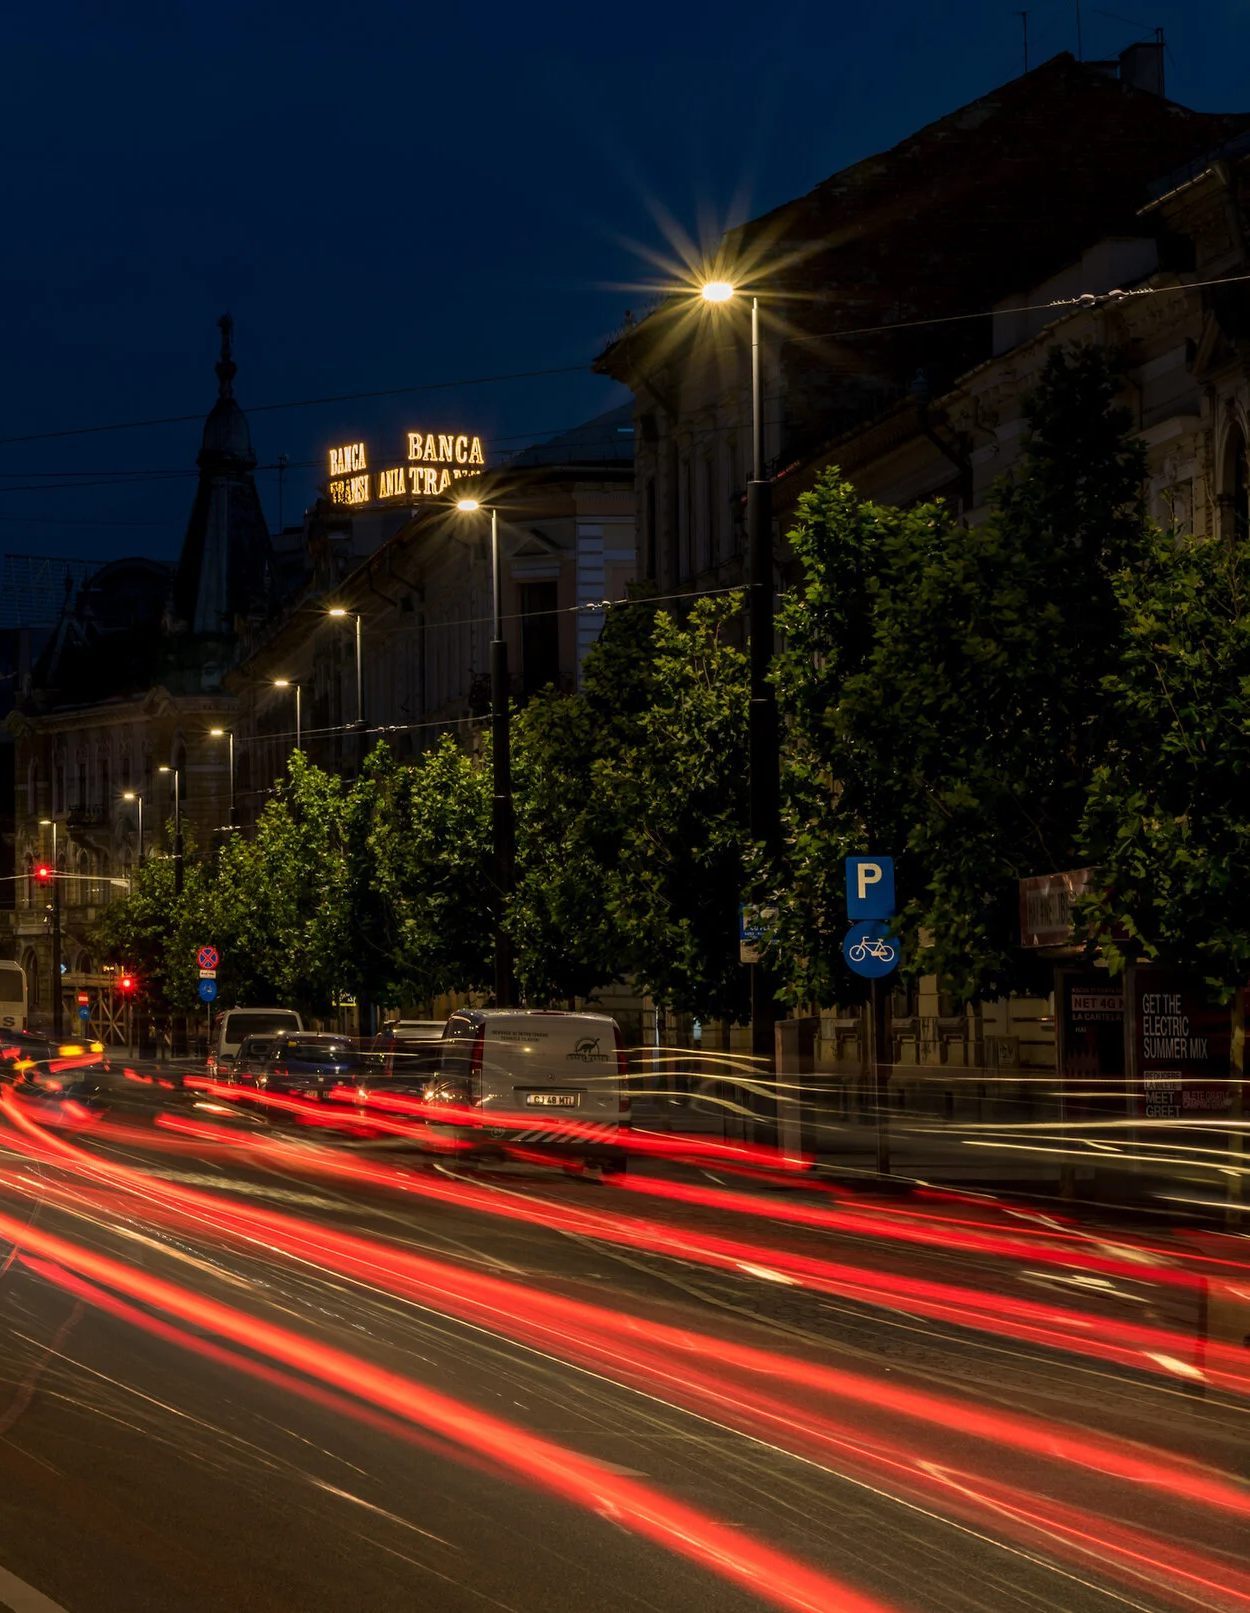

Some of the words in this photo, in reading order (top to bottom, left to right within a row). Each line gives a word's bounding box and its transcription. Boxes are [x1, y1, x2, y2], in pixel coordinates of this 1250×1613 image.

[408, 433, 484, 464] BANCA
[329, 443, 366, 476] BANCA
[857, 862, 883, 899] P
[1074, 998, 1096, 1008] NET
[1101, 998, 1115, 1008] 4G
[1142, 993, 1161, 1014] GET
[1162, 993, 1182, 1015] THE
[1072, 1012, 1083, 1021] LA
[1143, 1016, 1190, 1037] ELECTRIC
[1144, 1037, 1188, 1059] SUMMER
[1189, 1037, 1208, 1060] MIX
[534, 1096, 544, 1104] CJ
[547, 1096, 556, 1104] 48
[1146, 1091, 1174, 1104] MEET
[1146, 1104, 1182, 1118] GREET
